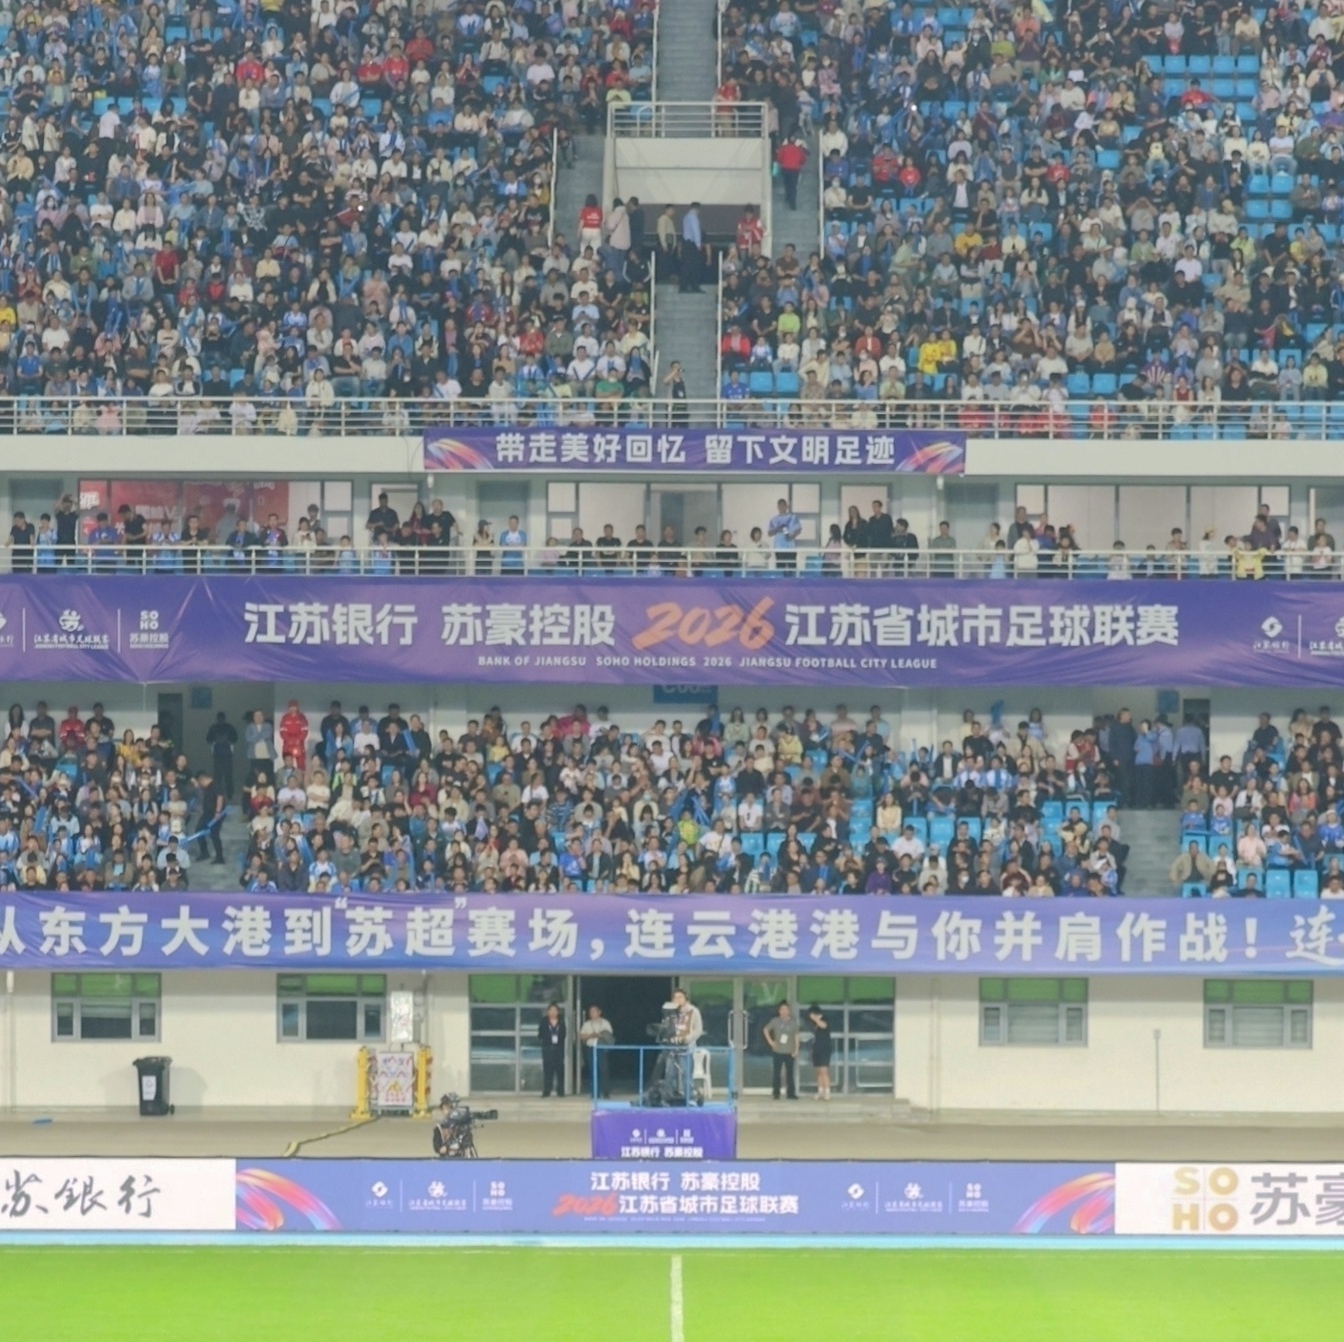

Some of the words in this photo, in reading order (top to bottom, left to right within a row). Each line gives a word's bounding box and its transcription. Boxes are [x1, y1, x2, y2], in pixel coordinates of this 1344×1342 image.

[496, 432, 686, 464] 带走美好回忆
[705, 433, 896, 466] 留下文明足迹
[244, 601, 418, 647] 江苏银行
[441, 602, 616, 648] 苏豪控股
[631, 596, 776, 651] 2026
[784, 602, 1180, 648] 江苏省城市足球联赛
[478, 655, 512, 666] BANK
[515, 655, 530, 667] OF
[534, 656, 587, 667] JIANGSU
[596, 656, 630, 667] SOHO
[633, 656, 696, 668] HOLDINGS
[703, 656, 732, 668] 2026
[740, 656, 791, 668] JIANGSU
[795, 657, 857, 669] FOOTBALL
[860, 657, 887, 669] CITY
[891, 657, 937, 669] LEAGUE
[590, 1171, 671, 1192] 江苏银行
[680, 1171, 761, 1192] 苏豪控股
[1172, 1166, 1239, 1196] SO
[619, 1194, 799, 1215] 江苏省城市足球联赛
[1172, 1202, 1239, 1232] HO
